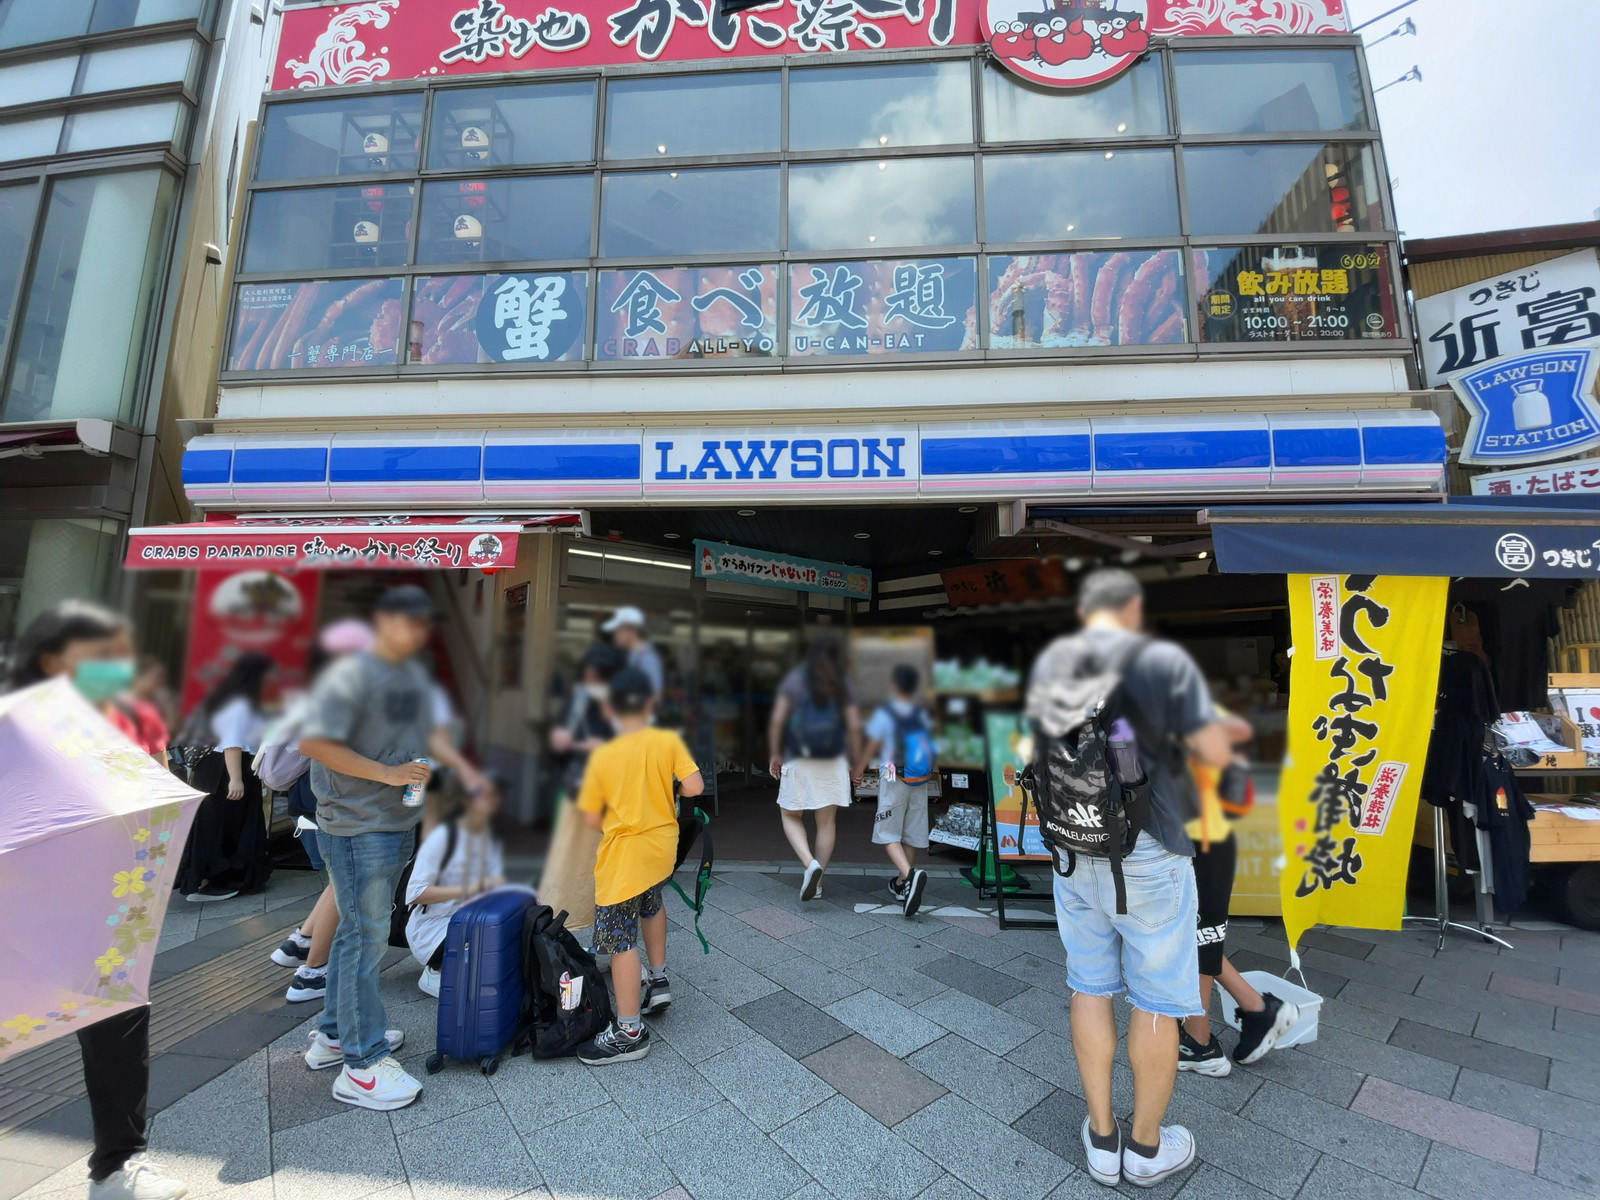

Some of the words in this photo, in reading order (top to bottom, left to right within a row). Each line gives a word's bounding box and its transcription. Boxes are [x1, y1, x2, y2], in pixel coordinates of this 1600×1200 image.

[1237, 269, 1349, 296] 飲み放題
[1469, 271, 1540, 306] つきじ
[494, 276, 567, 361] 蟹
[611, 263, 956, 339] 食べ放題
[1269, 296, 1285, 304] you
[1245, 316, 1288, 329] 10:00
[1307, 315, 1349, 328] 21:00
[604, 336, 681, 357] CRAB
[1475, 360, 1578, 391] LAWSON
[1485, 418, 1590, 447] STATION
[655, 437, 906, 480] LAWSON
[142, 545, 199, 560] CRABS
[206, 544, 298, 559] PARADISE
[1543, 548, 1592, 568] つきじ
